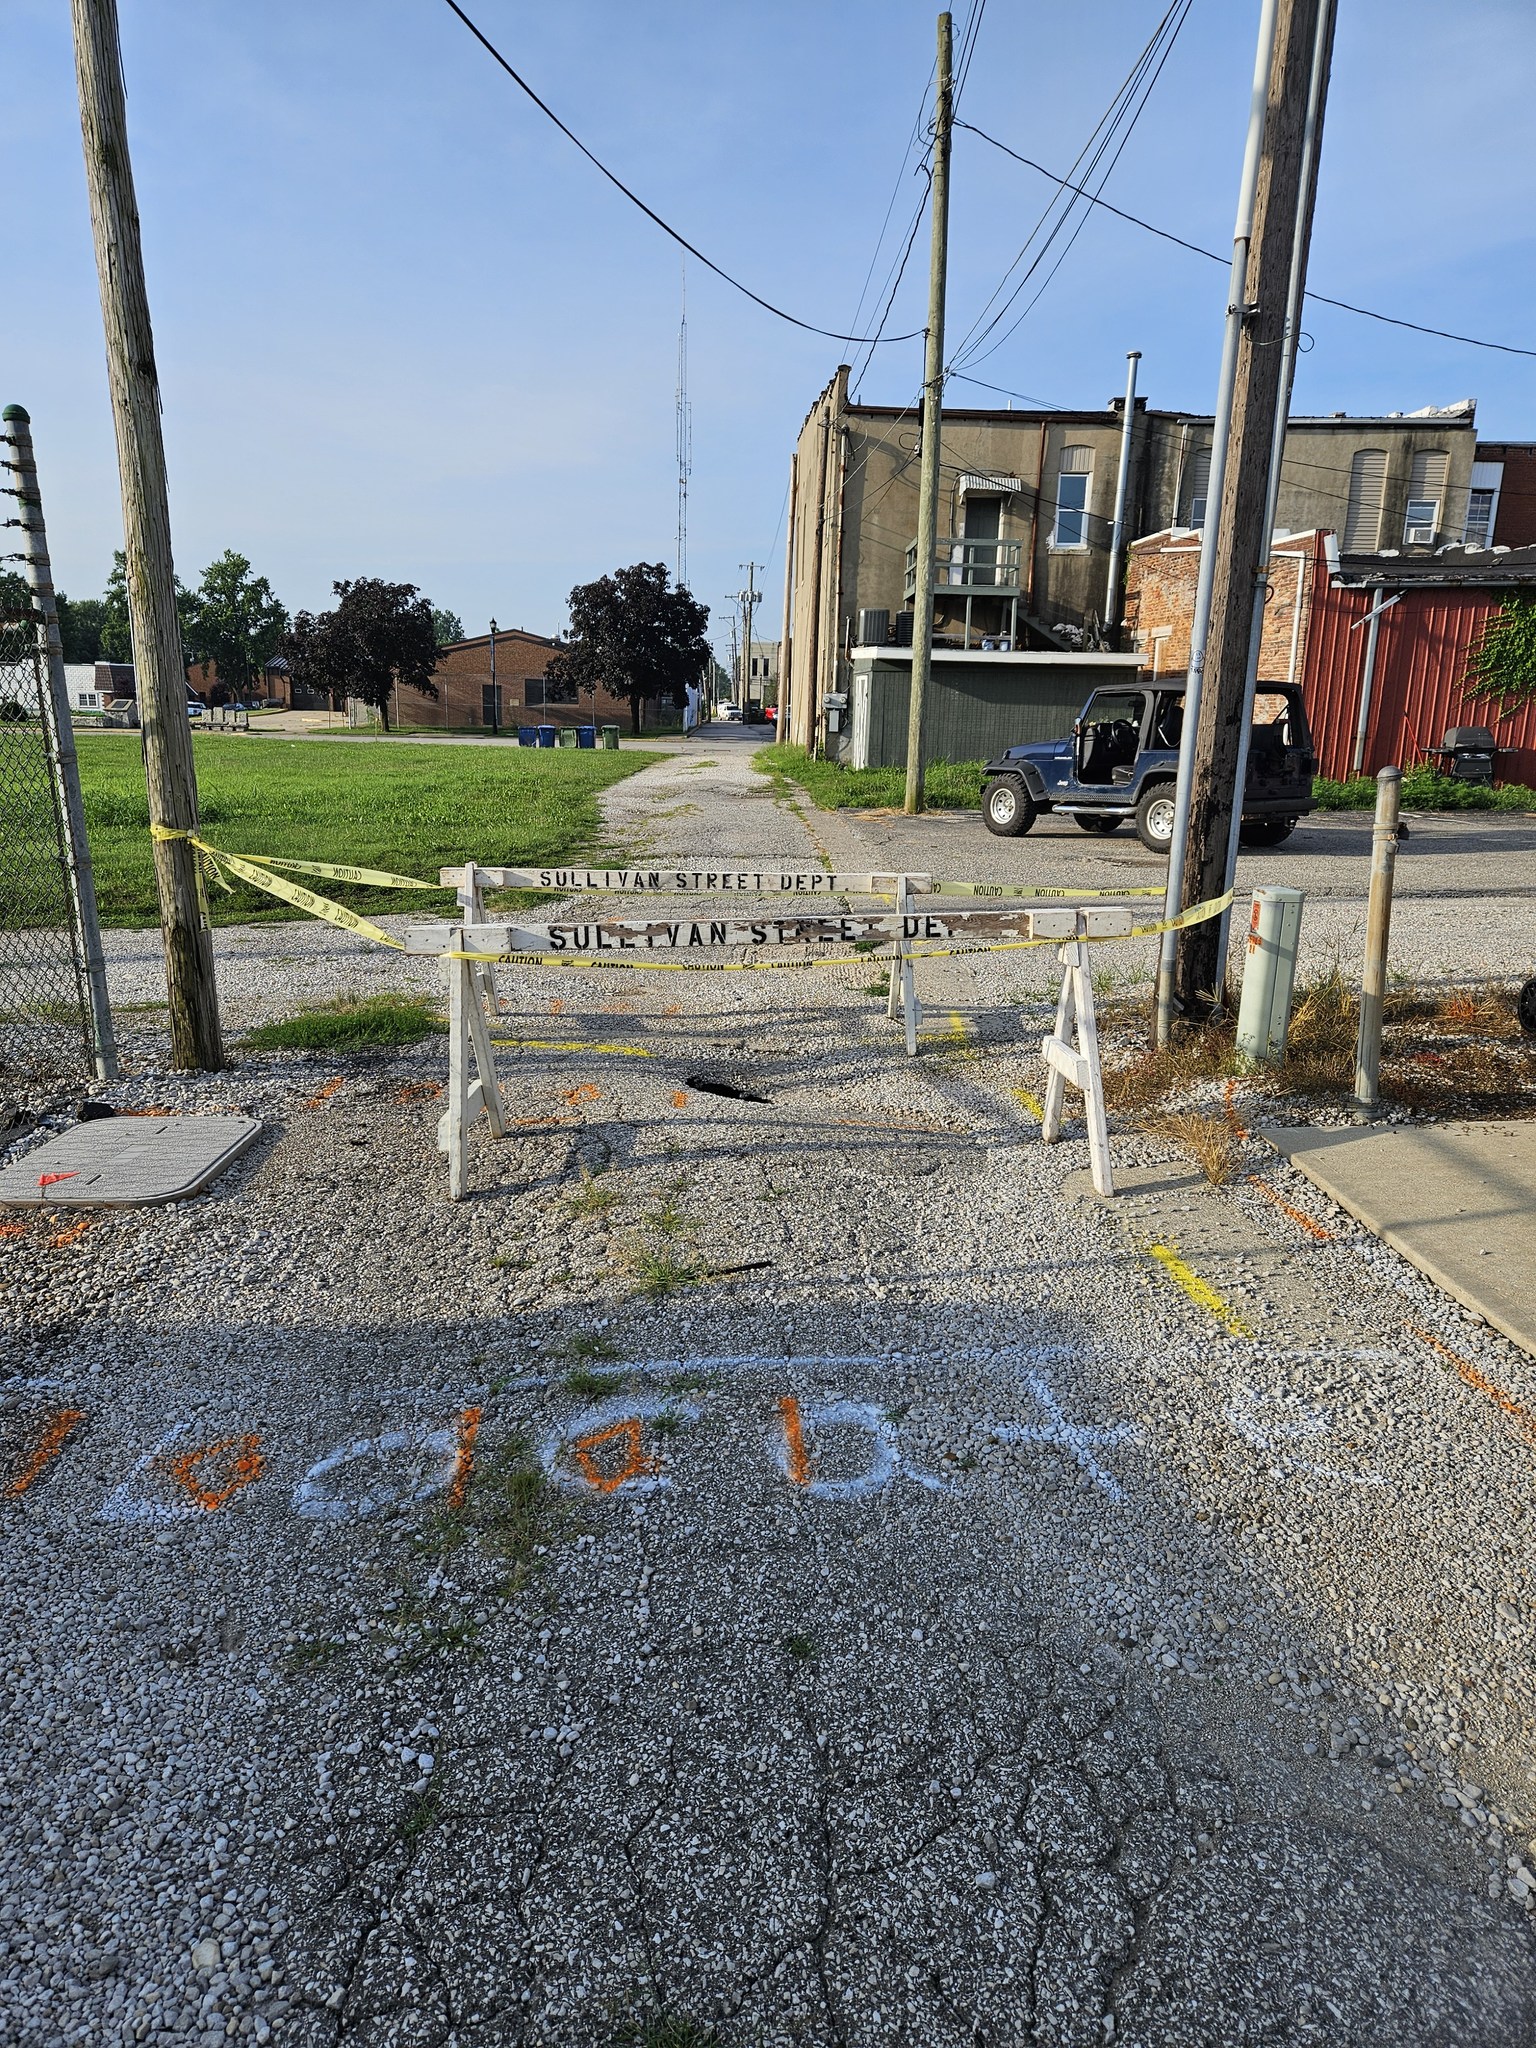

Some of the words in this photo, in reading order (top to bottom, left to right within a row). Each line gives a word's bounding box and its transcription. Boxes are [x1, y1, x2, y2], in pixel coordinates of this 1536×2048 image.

[540, 871, 659, 887] SULLIVAN
[676, 872, 763, 890] STREET
[973, 885, 1002, 897] CAUTION
